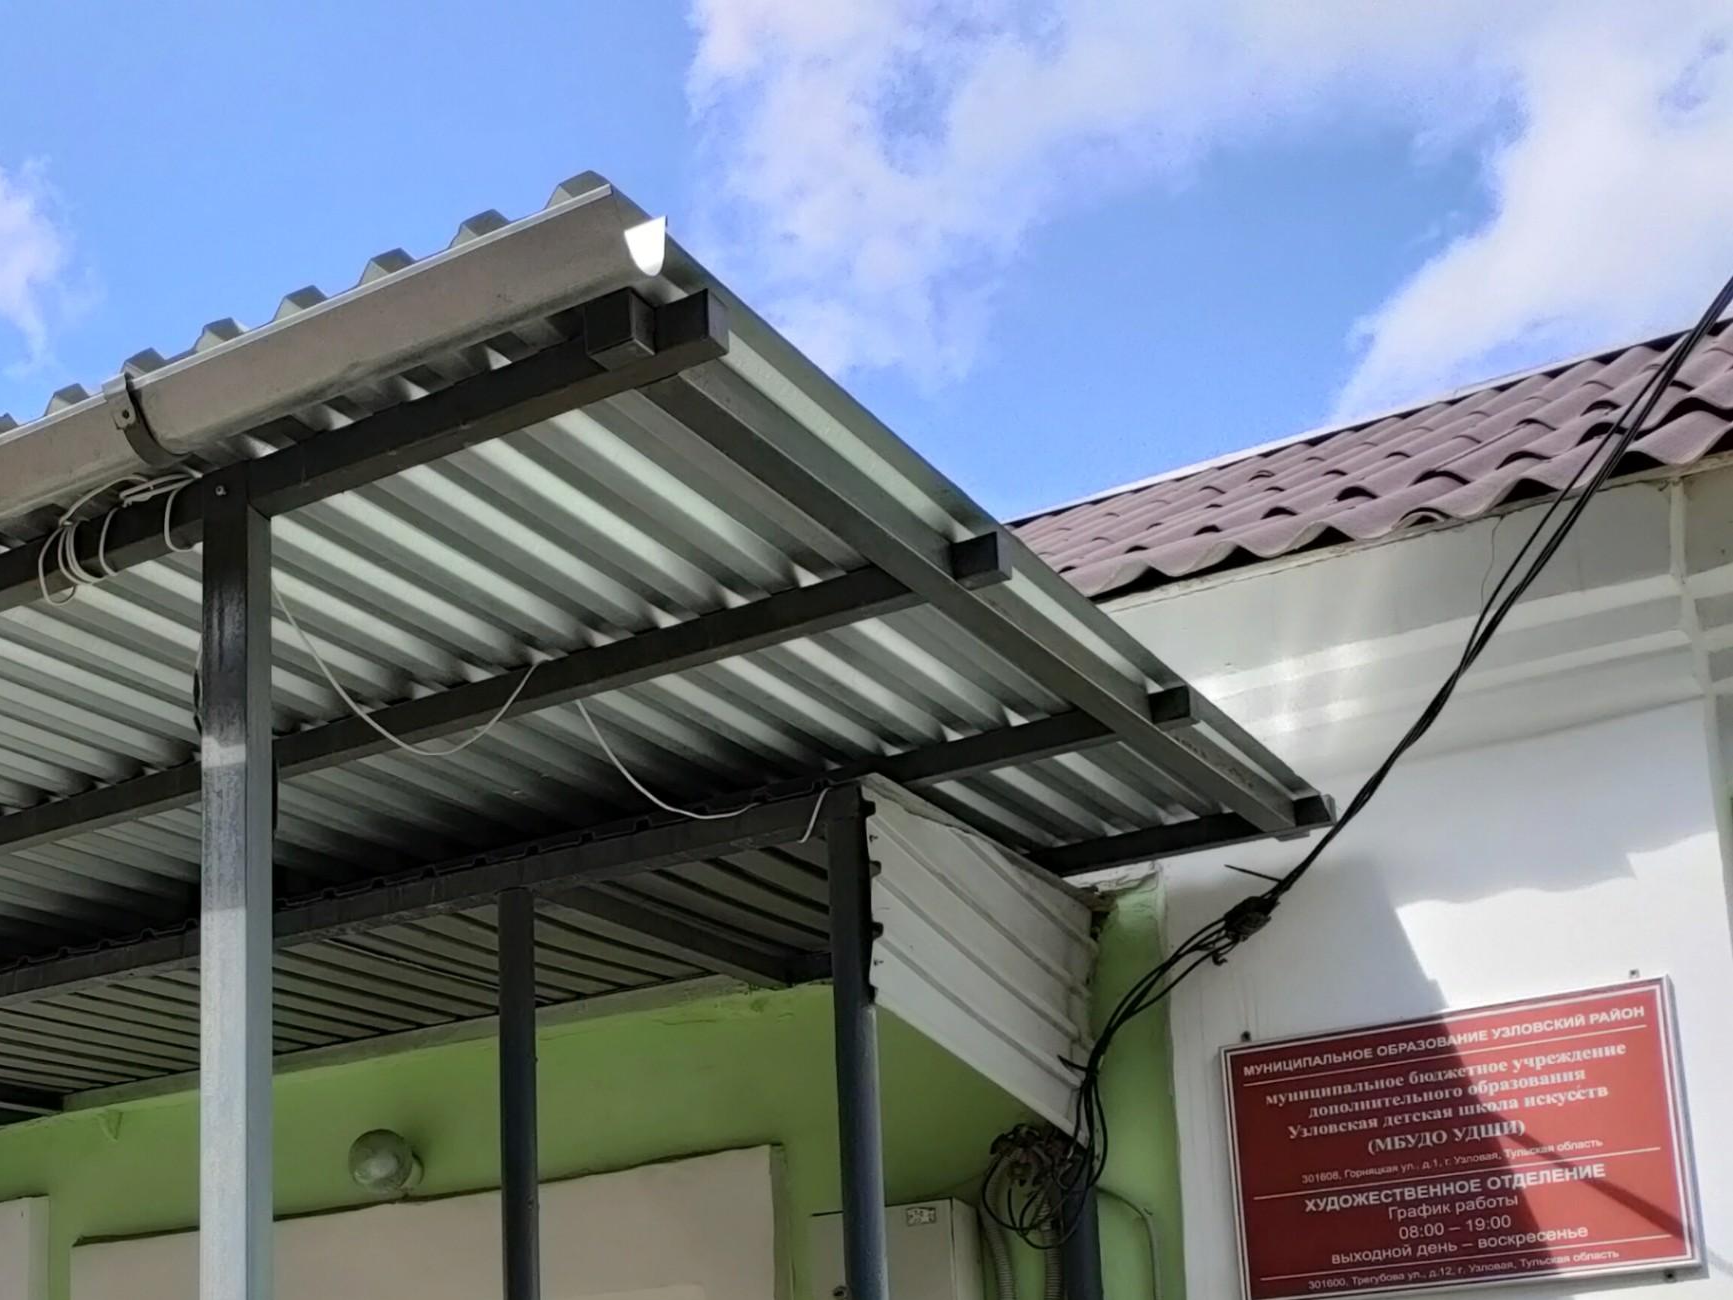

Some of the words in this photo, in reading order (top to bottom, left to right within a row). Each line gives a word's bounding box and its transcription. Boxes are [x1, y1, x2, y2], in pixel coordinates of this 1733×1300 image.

[1244, 1048, 1372, 1077] МУНИЦИПАЛЬНОЕ
[1377, 1030, 1488, 1056] ОБРАЗОВАНИЕ
[1492, 1015, 1585, 1039] УЗЛОВСКИЙ
[1590, 1006, 1645, 1024] РАЙОН
[1266, 1076, 1404, 1107] муниципальное
[1409, 1060, 1508, 1085] бюджетное
[1512, 1044, 1626, 1073] учреждение
[1309, 1088, 1462, 1118] дополнительного
[1468, 1070, 1586, 1097] образования
[1288, 1115, 1378, 1139] Узловская
[1383, 1107, 1453, 1128] детская
[1459, 1098, 1518, 1116] школа
[1524, 1086, 1608, 1112] искусств
[1368, 1129, 1447, 1155] (МБУДО
[1452, 1119, 1526, 1142] УДШИ)
[1345, 1165, 1398, 1178] Горняцкая
[1504, 1144, 1555, 1158] Тульская
[1557, 1138, 1603, 1152] область
[1305, 1180, 1482, 1213] ХУДОЖЕСТВЕННОЕ
[1487, 1164, 1605, 1190] ОТДЕЛЕНИЕ
[1389, 1202, 1451, 1222] График
[1455, 1195, 1518, 1214] работы
[1332, 1243, 1411, 1264] выходной
[1417, 1241, 1457, 1257] день
[1478, 1227, 1588, 1249] воскресенье
[1399, 1222, 1444, 1240] 08:00
[1466, 1215, 1511, 1233] 19:00
[1520, 1254, 1570, 1268] Тульская
[1573, 1249, 1619, 1263] область
